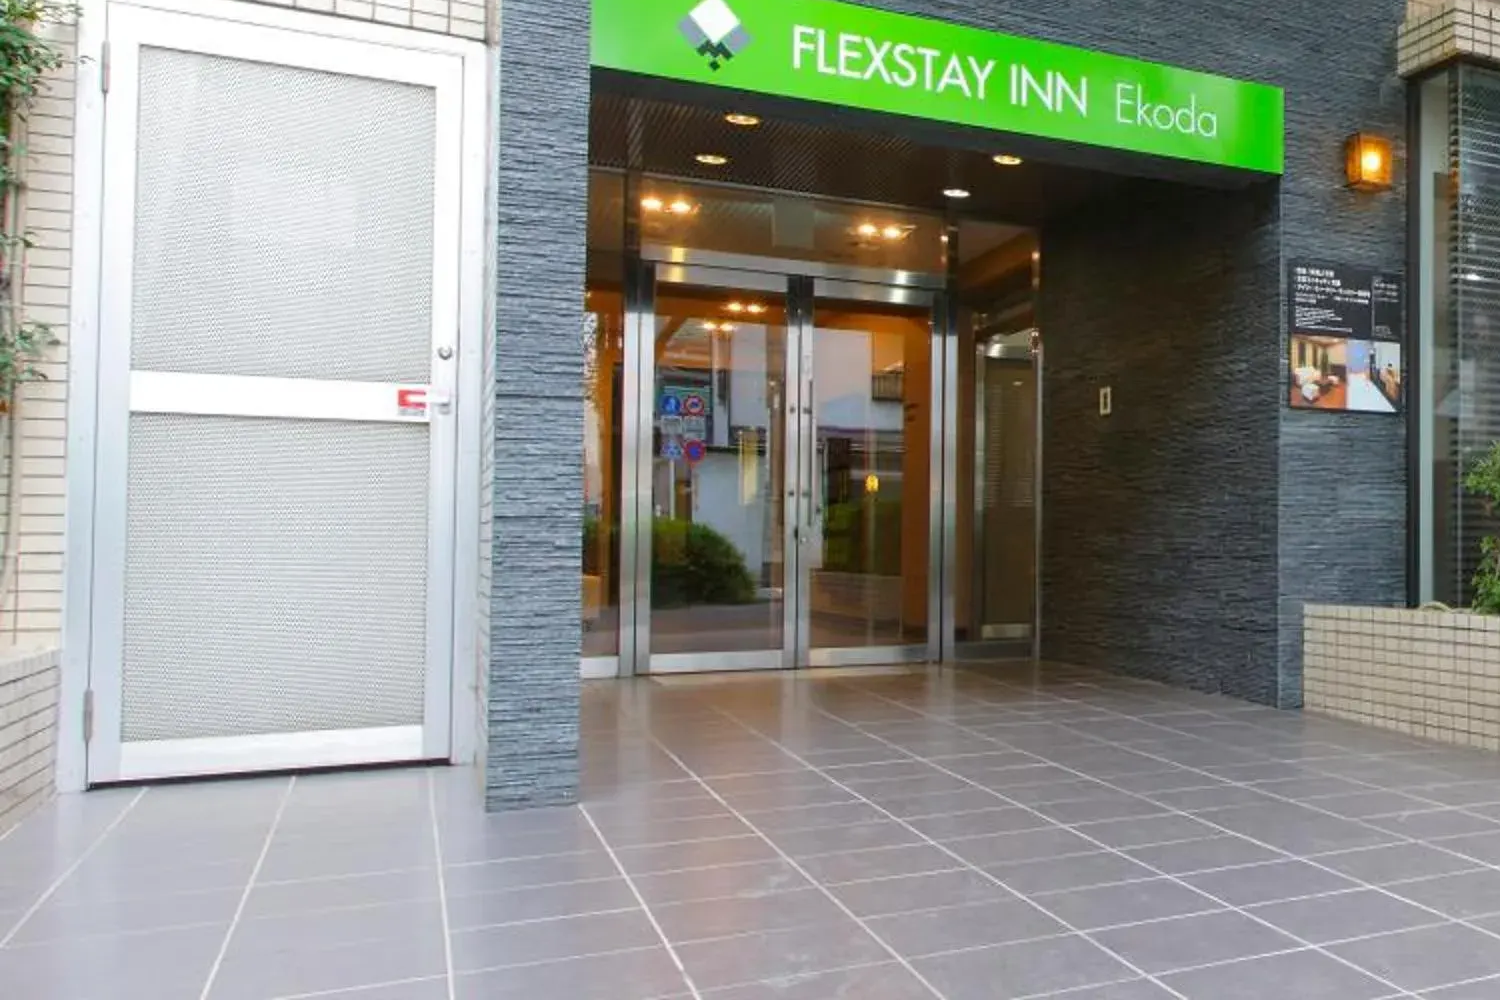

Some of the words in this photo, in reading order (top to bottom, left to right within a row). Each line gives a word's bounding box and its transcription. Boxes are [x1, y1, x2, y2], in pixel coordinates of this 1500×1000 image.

[792, 24, 997, 100] FLEXSTAY
[1009, 63, 1089, 119] INN
[1115, 82, 1218, 139] Ekoda
